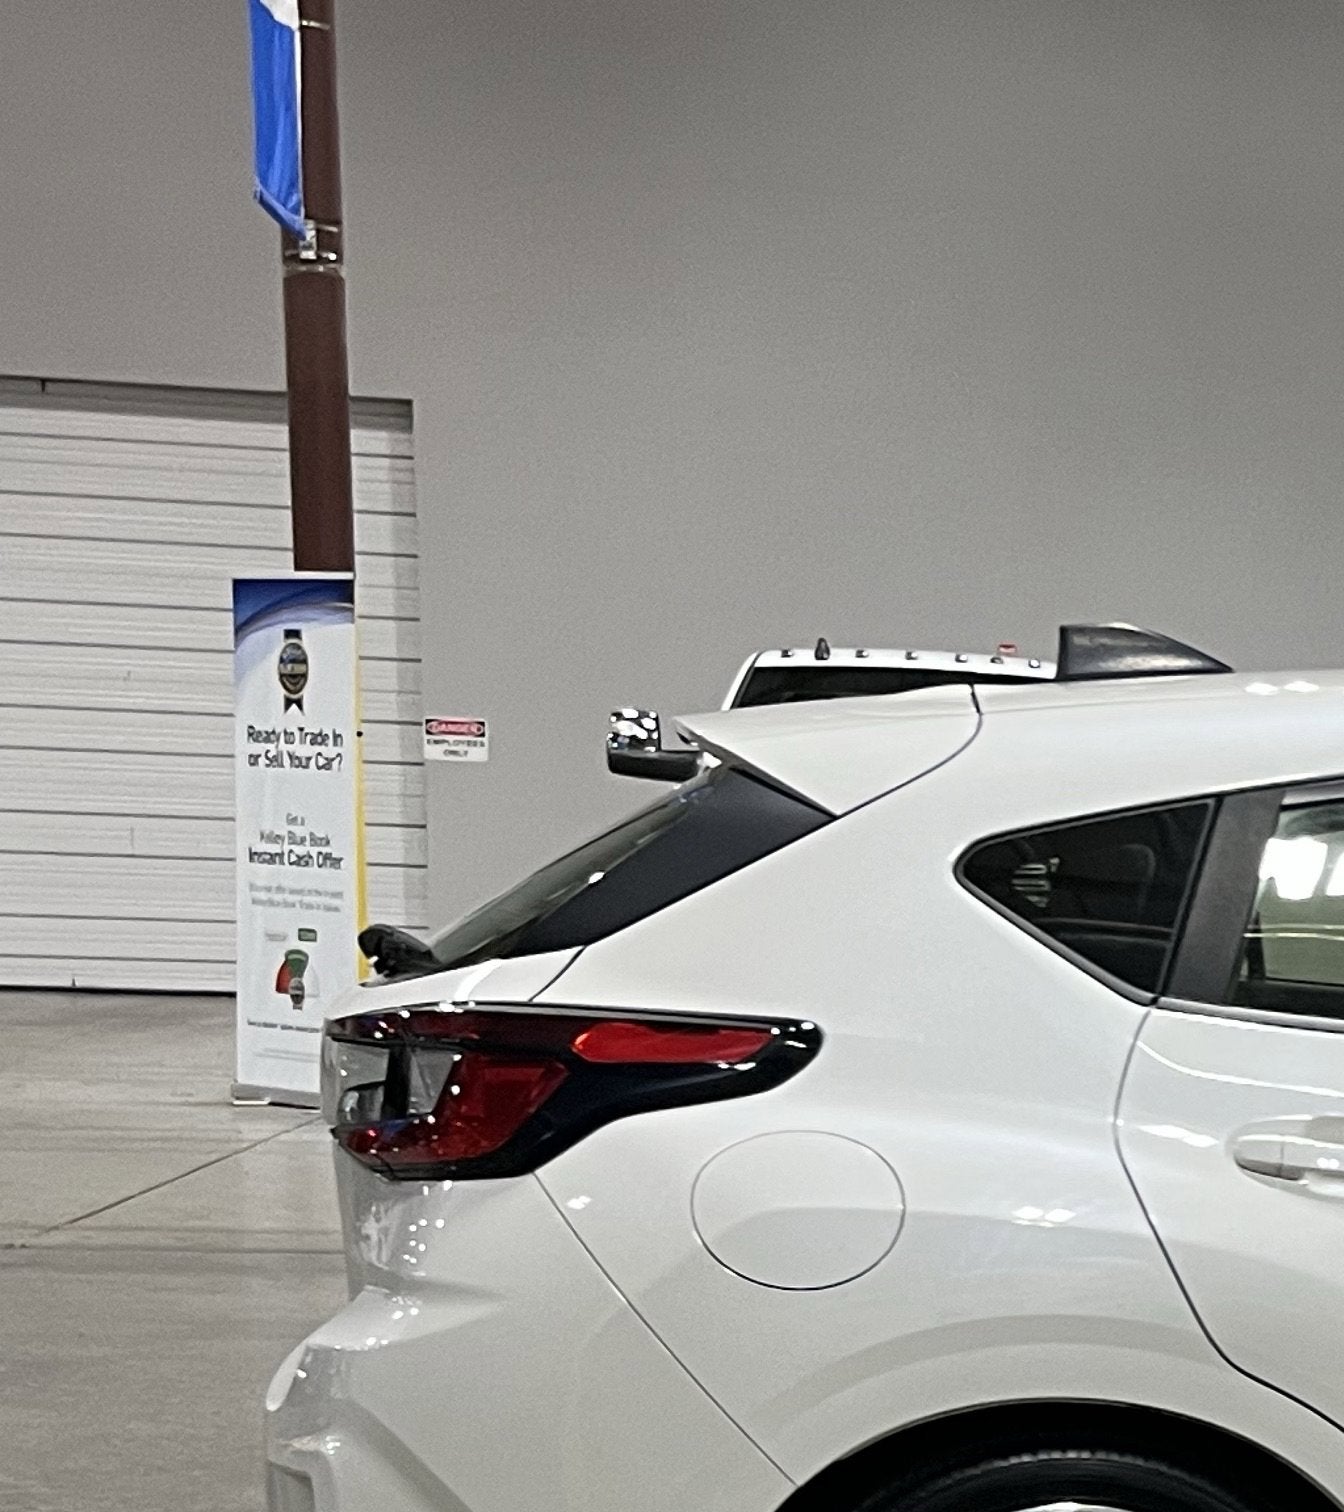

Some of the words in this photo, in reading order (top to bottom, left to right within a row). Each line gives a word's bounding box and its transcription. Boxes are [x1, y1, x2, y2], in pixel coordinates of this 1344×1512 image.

[246, 724, 282, 749] Ready
[283, 727, 296, 745] to
[297, 726, 330, 747] Trade
[332, 728, 344, 747] In
[247, 753, 262, 767] or
[265, 749, 285, 768] Sell
[286, 750, 313, 769] Your
[315, 751, 343, 772] Car?
[248, 847, 286, 866] Instant
[287, 849, 314, 868] Cash
[316, 851, 344, 870] Offer
